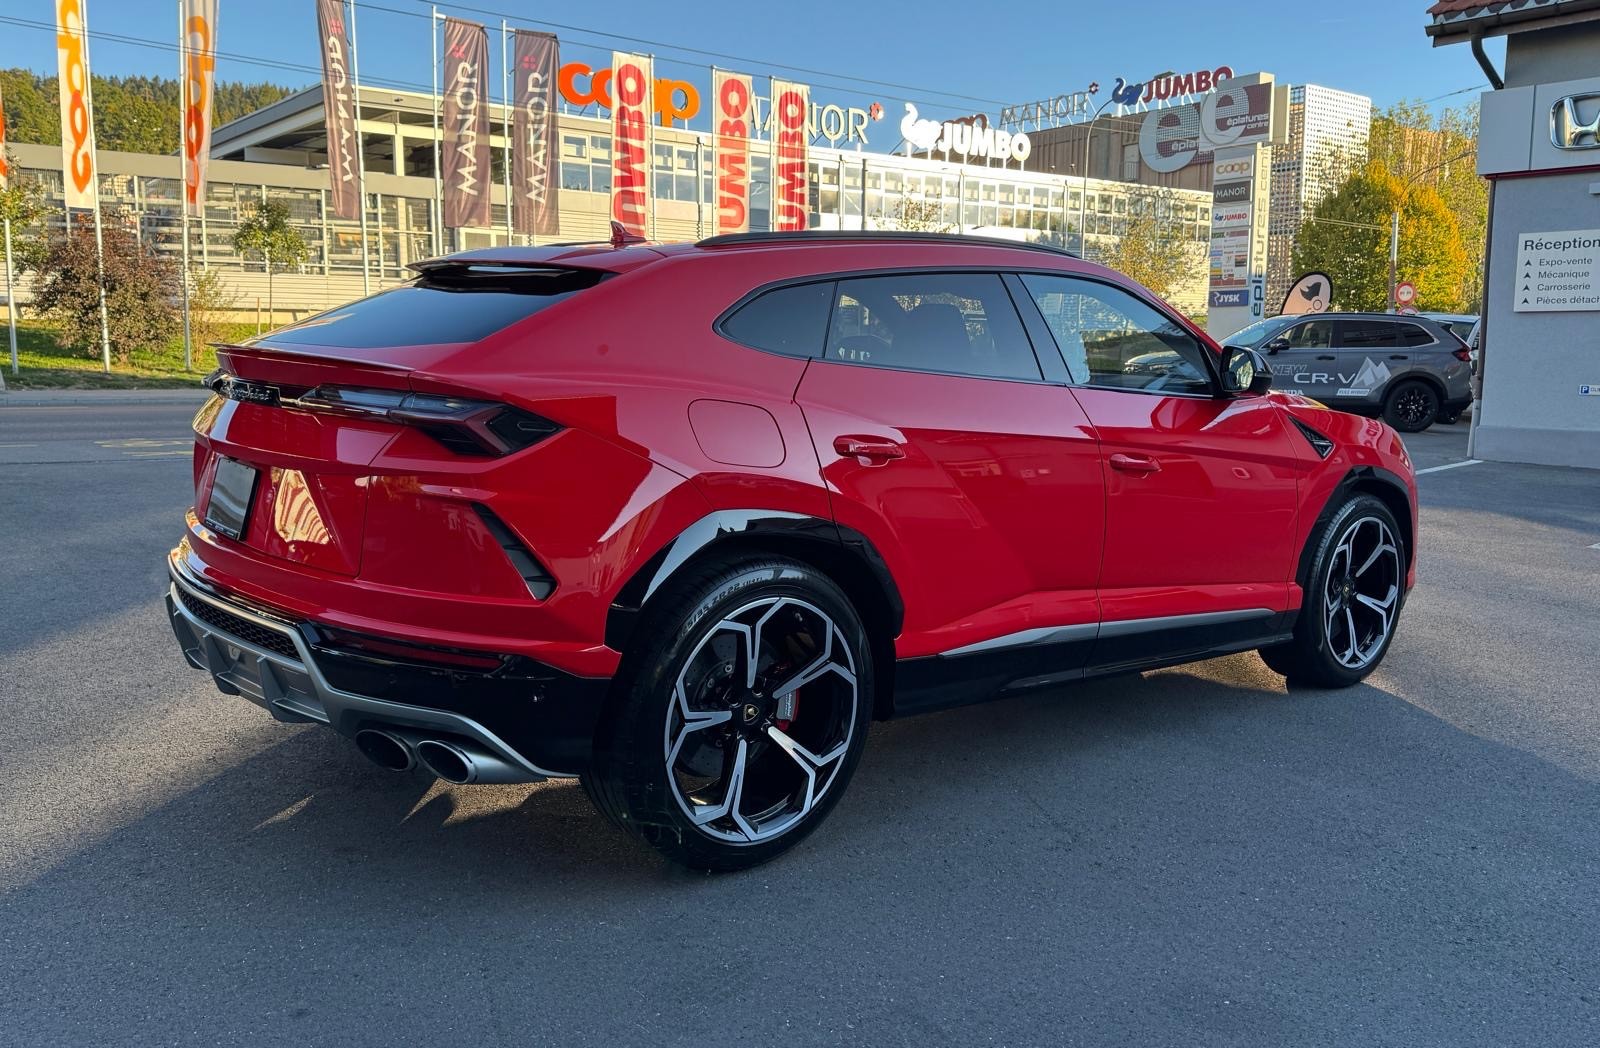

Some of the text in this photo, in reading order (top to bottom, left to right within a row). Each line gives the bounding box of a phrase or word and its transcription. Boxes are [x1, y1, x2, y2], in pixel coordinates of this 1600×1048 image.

[1143, 66, 1233, 101] JUMBO
[1001, 91, 1087, 126] MANOR
[456, 62, 478, 196] MANOR
[526, 72, 548, 204] MANOR
[938, 122, 1031, 161] JUMBO
[719, 78, 747, 234] UMBO
[778, 91, 807, 231] UMBO
[1216, 162, 1250, 174] coop
[1215, 187, 1246, 198] MANOR
[1223, 212, 1248, 221] JUMBO
[1539, 257, 1593, 267] Expo-vente
[1538, 270, 1590, 280] Mécanique
[1537, 282, 1591, 291] Carrosserie
[1219, 293, 1240, 303] JYSK
[1536, 296, 1567, 305] Pièces
[1273, 364, 1307, 376] NEW
[1294, 373, 1356, 384] CR-V
